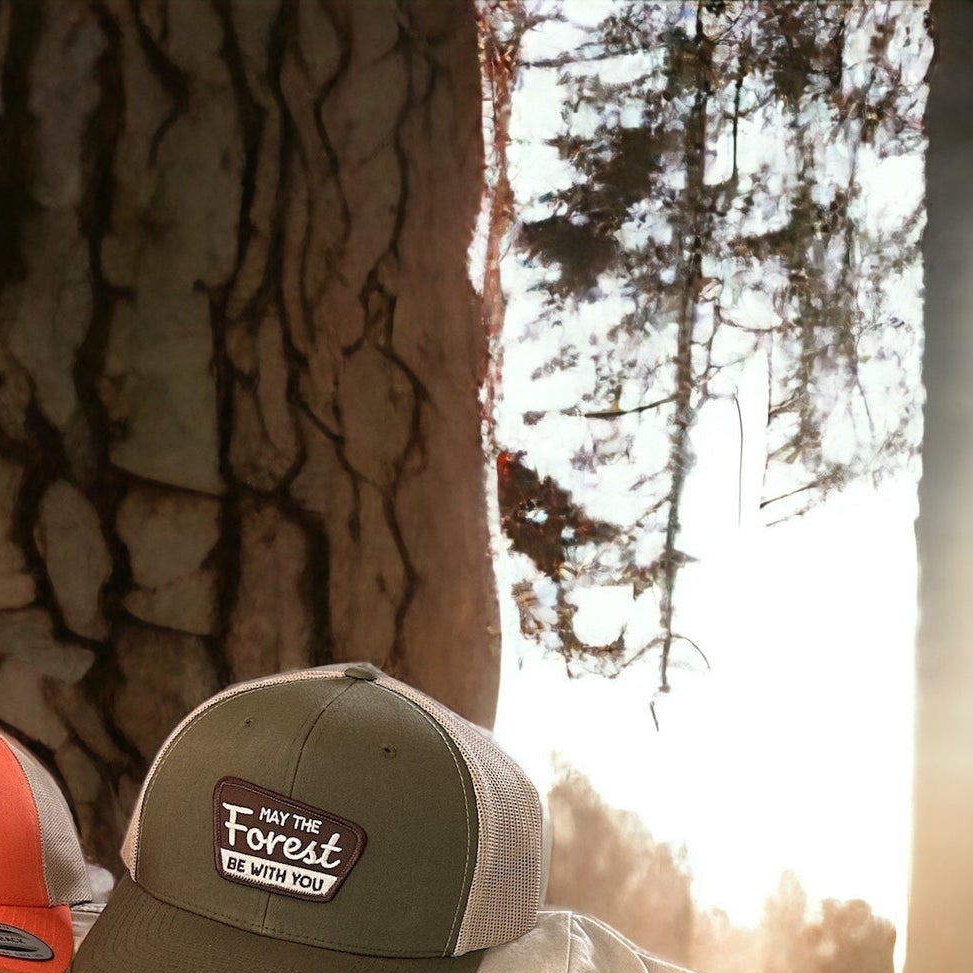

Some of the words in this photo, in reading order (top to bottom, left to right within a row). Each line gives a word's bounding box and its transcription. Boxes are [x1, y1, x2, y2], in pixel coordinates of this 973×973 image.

[222, 802, 342, 869] Forest
[259, 806, 290, 827] MAY
[292, 814, 322, 834] THE
[226, 856, 246, 872] BE
[250, 862, 287, 883] WITH
[291, 871, 324, 892] YOU
